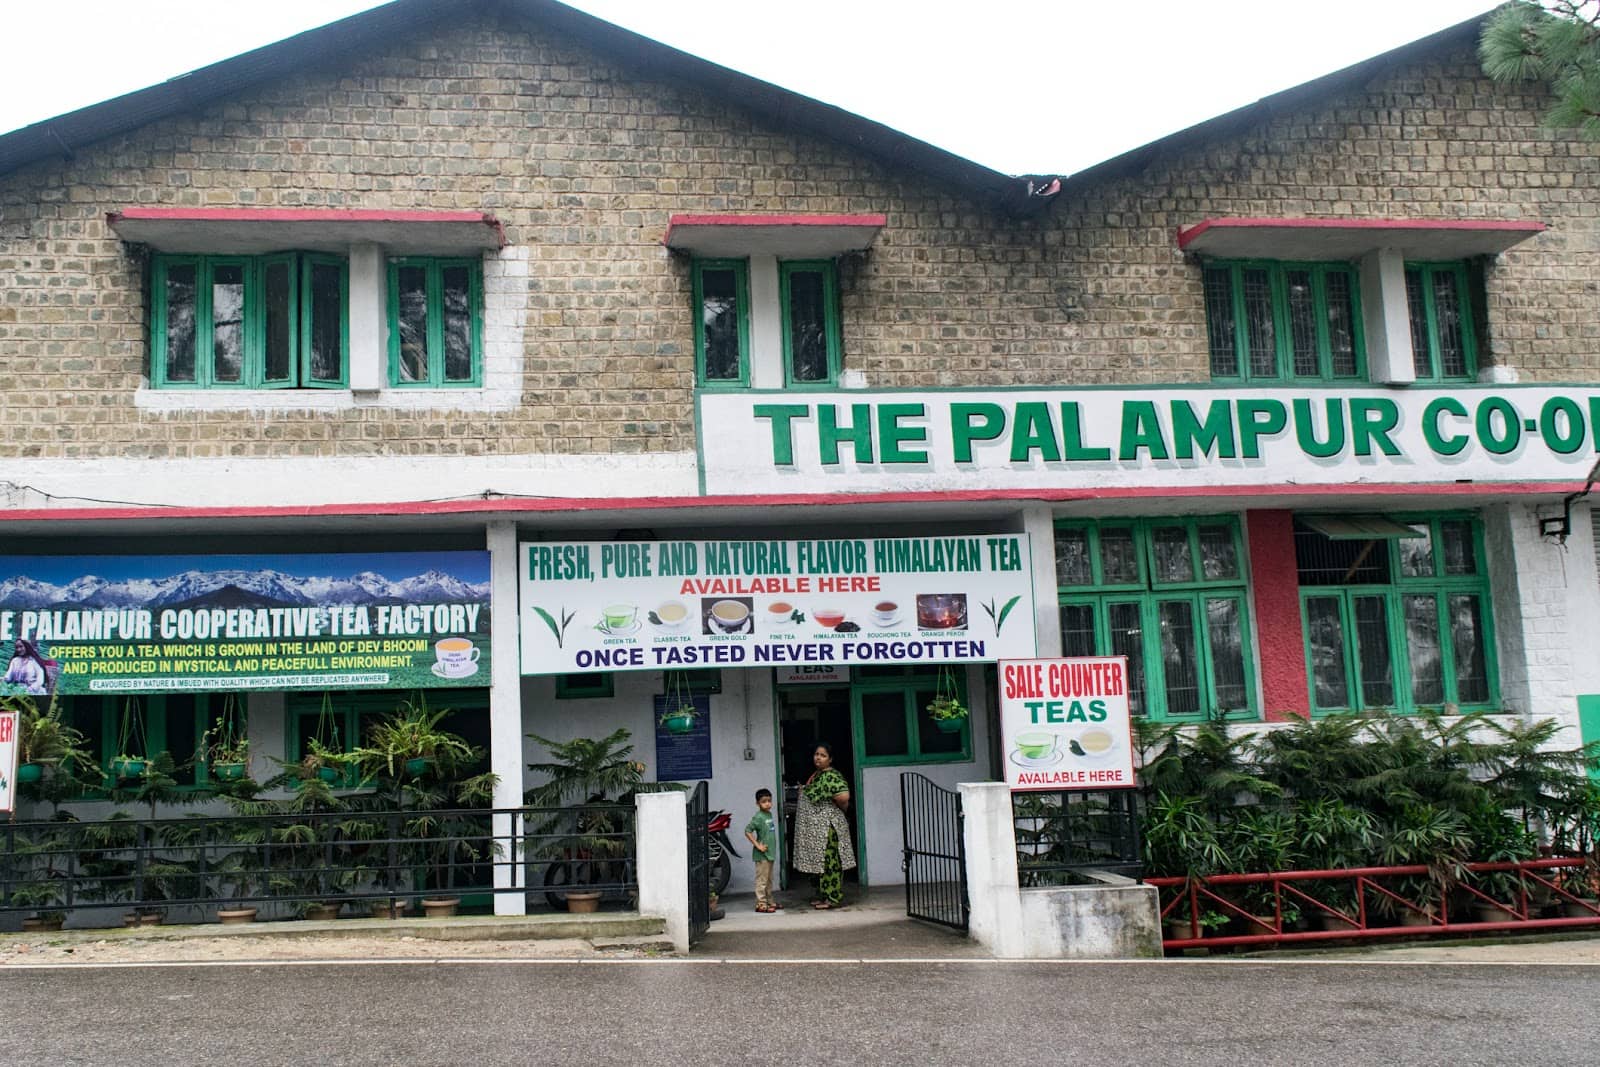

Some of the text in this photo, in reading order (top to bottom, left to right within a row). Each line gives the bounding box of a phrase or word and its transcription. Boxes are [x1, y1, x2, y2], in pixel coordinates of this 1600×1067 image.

[753, 402, 929, 466] THE
[949, 397, 1403, 464] PALAMPUR
[528, 538, 1022, 582] FRESH, PURE AND NATURAL FLAVOR HIMALAYAN TEA
[679, 576, 881, 595] AVAILABLE HERE
[0, 604, 480, 640] E PALAMPUR COOPERATIVE TEA FACTORY
[48, 640, 428, 659] OFFERS YOU A TEA WHICH IS GROWN IN THE LAND OF DEV BHOOMI
[575, 640, 985, 668] ONCE TASTED NEVER FORGOTTEN
[63, 655, 414, 674] AND PRODUCED IN MYSTICAL AND PEACEFULL ENVIRONMENT.
[93, 680, 132, 688] FLAVOURED
[133, 680, 142, 688] BY
[144, 679, 169, 687] NATURE
[203, 678, 220, 687] WITH
[220, 678, 248, 687] QUALITY
[249, 677, 271, 686] WHICH
[271, 677, 286, 685] CAN
[286, 676, 300, 685] NOT
[301, 676, 310, 684] BE
[311, 675, 351, 684] REPLICATED
[351, 674, 387, 683] ANYWHERE
[1004, 663, 1123, 700] SALE COUNTER
[1023, 699, 1108, 724] TEAS
[0, 717, 13, 743] ER
[1017, 770, 1123, 785] AVAILABLE HERE
